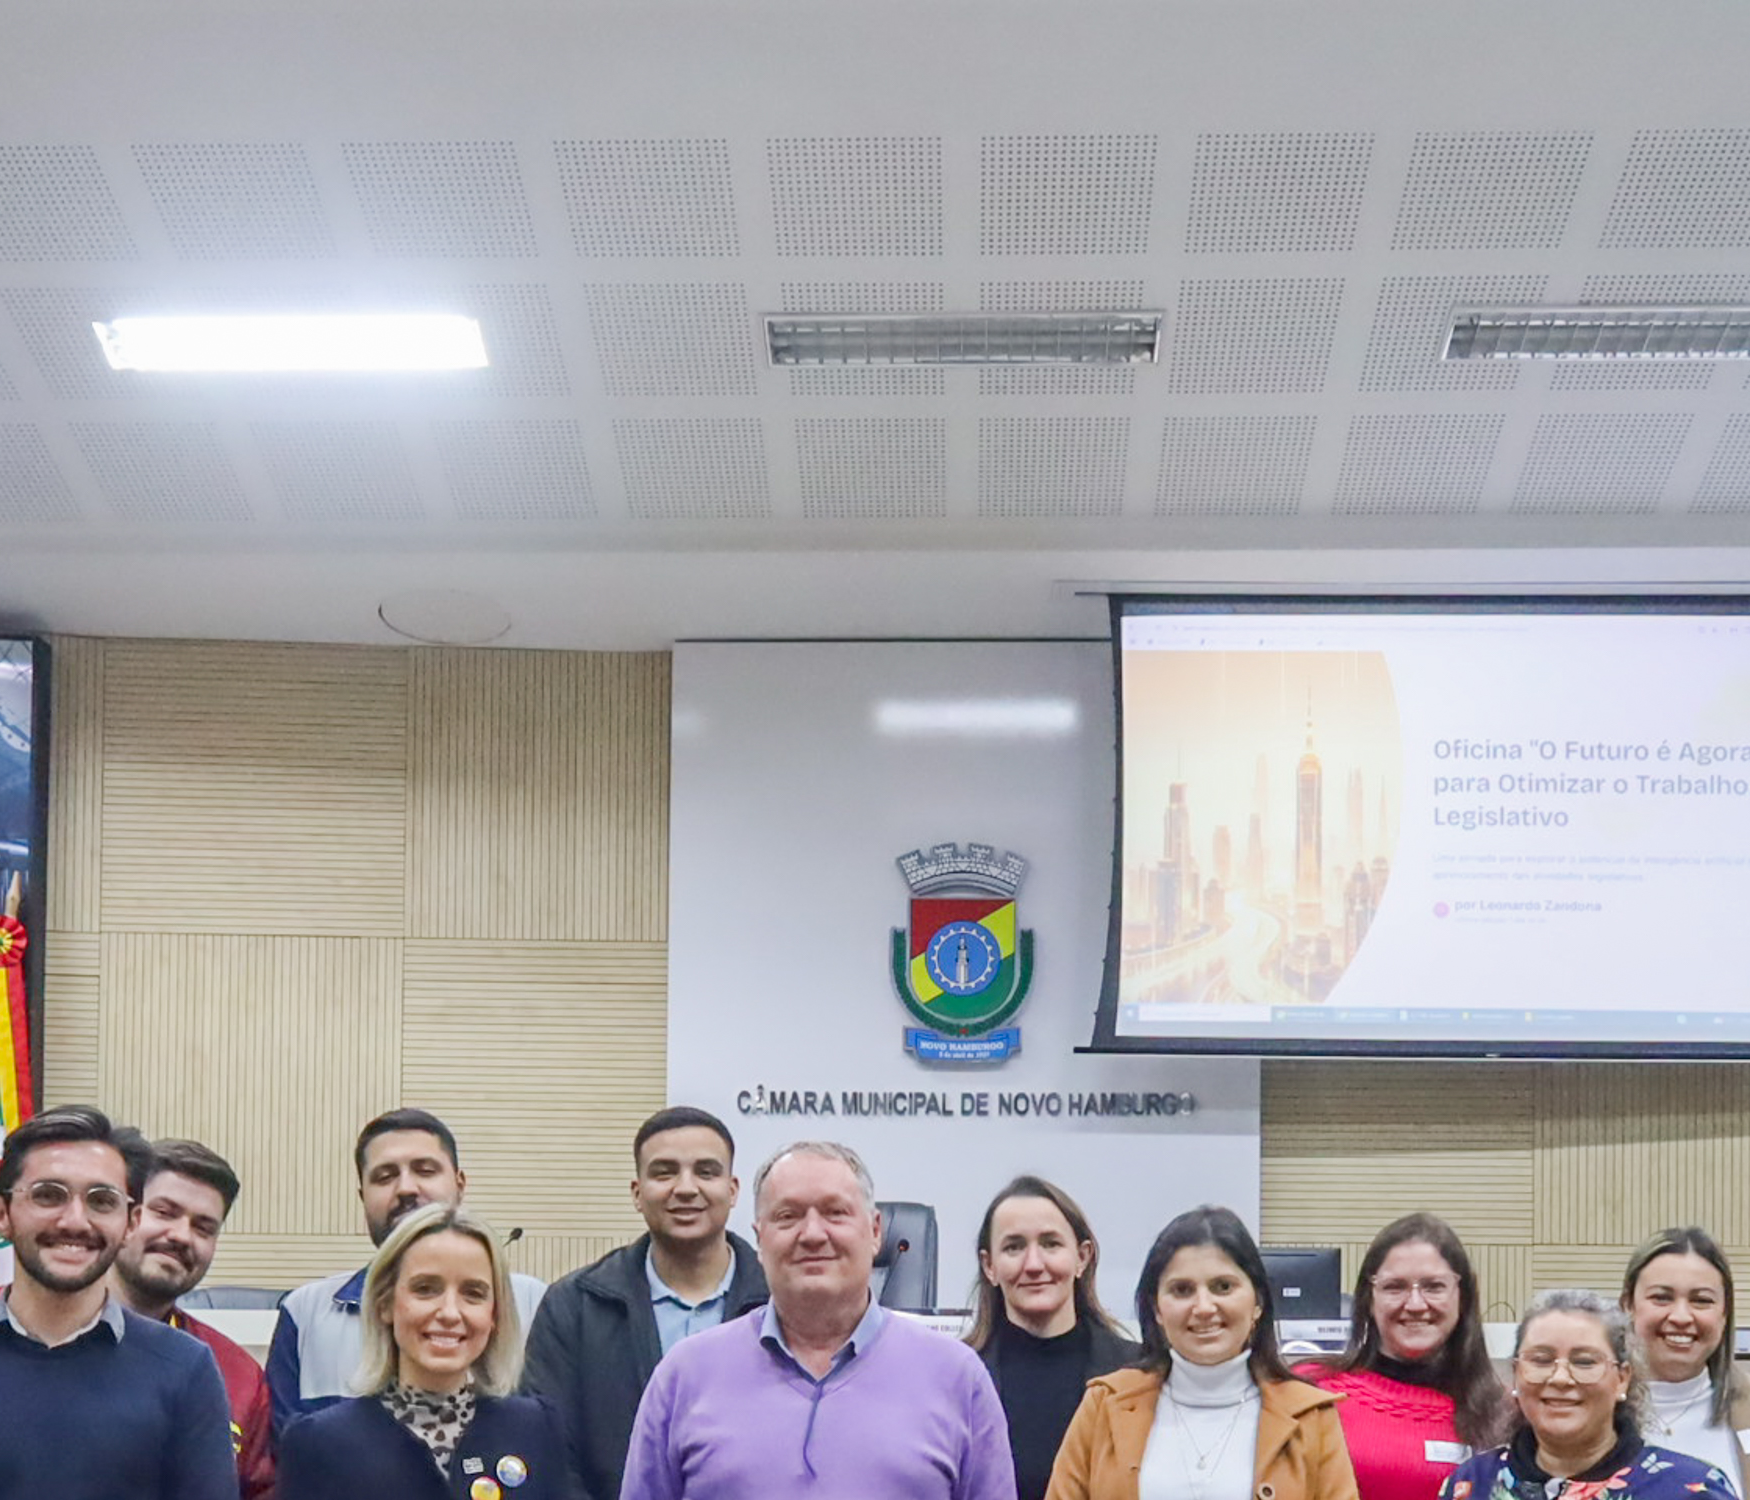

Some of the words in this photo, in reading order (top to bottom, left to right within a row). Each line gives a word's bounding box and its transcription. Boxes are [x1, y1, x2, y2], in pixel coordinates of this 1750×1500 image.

[1433, 739, 1523, 761] Oficina
[1529, 739, 1558, 761] "O
[1564, 740, 1650, 762] Futuro
[1656, 739, 1672, 762] é
[1433, 776, 1491, 796] para
[1498, 773, 1606, 795] Otimizar
[1613, 777, 1629, 795] o
[1636, 774, 1749, 797] Trabalho
[1433, 806, 1570, 831] Legislativo
[1454, 900, 1477, 913] por
[1479, 899, 1542, 912] Leonardo
[737, 1084, 836, 1116] CÂMARA
[841, 1091, 954, 1117] MUNICIPAL
[960, 1092, 989, 1117] DE
[997, 1092, 1062, 1117] NOVO
[1068, 1092, 1195, 1118] HAMBURGO
